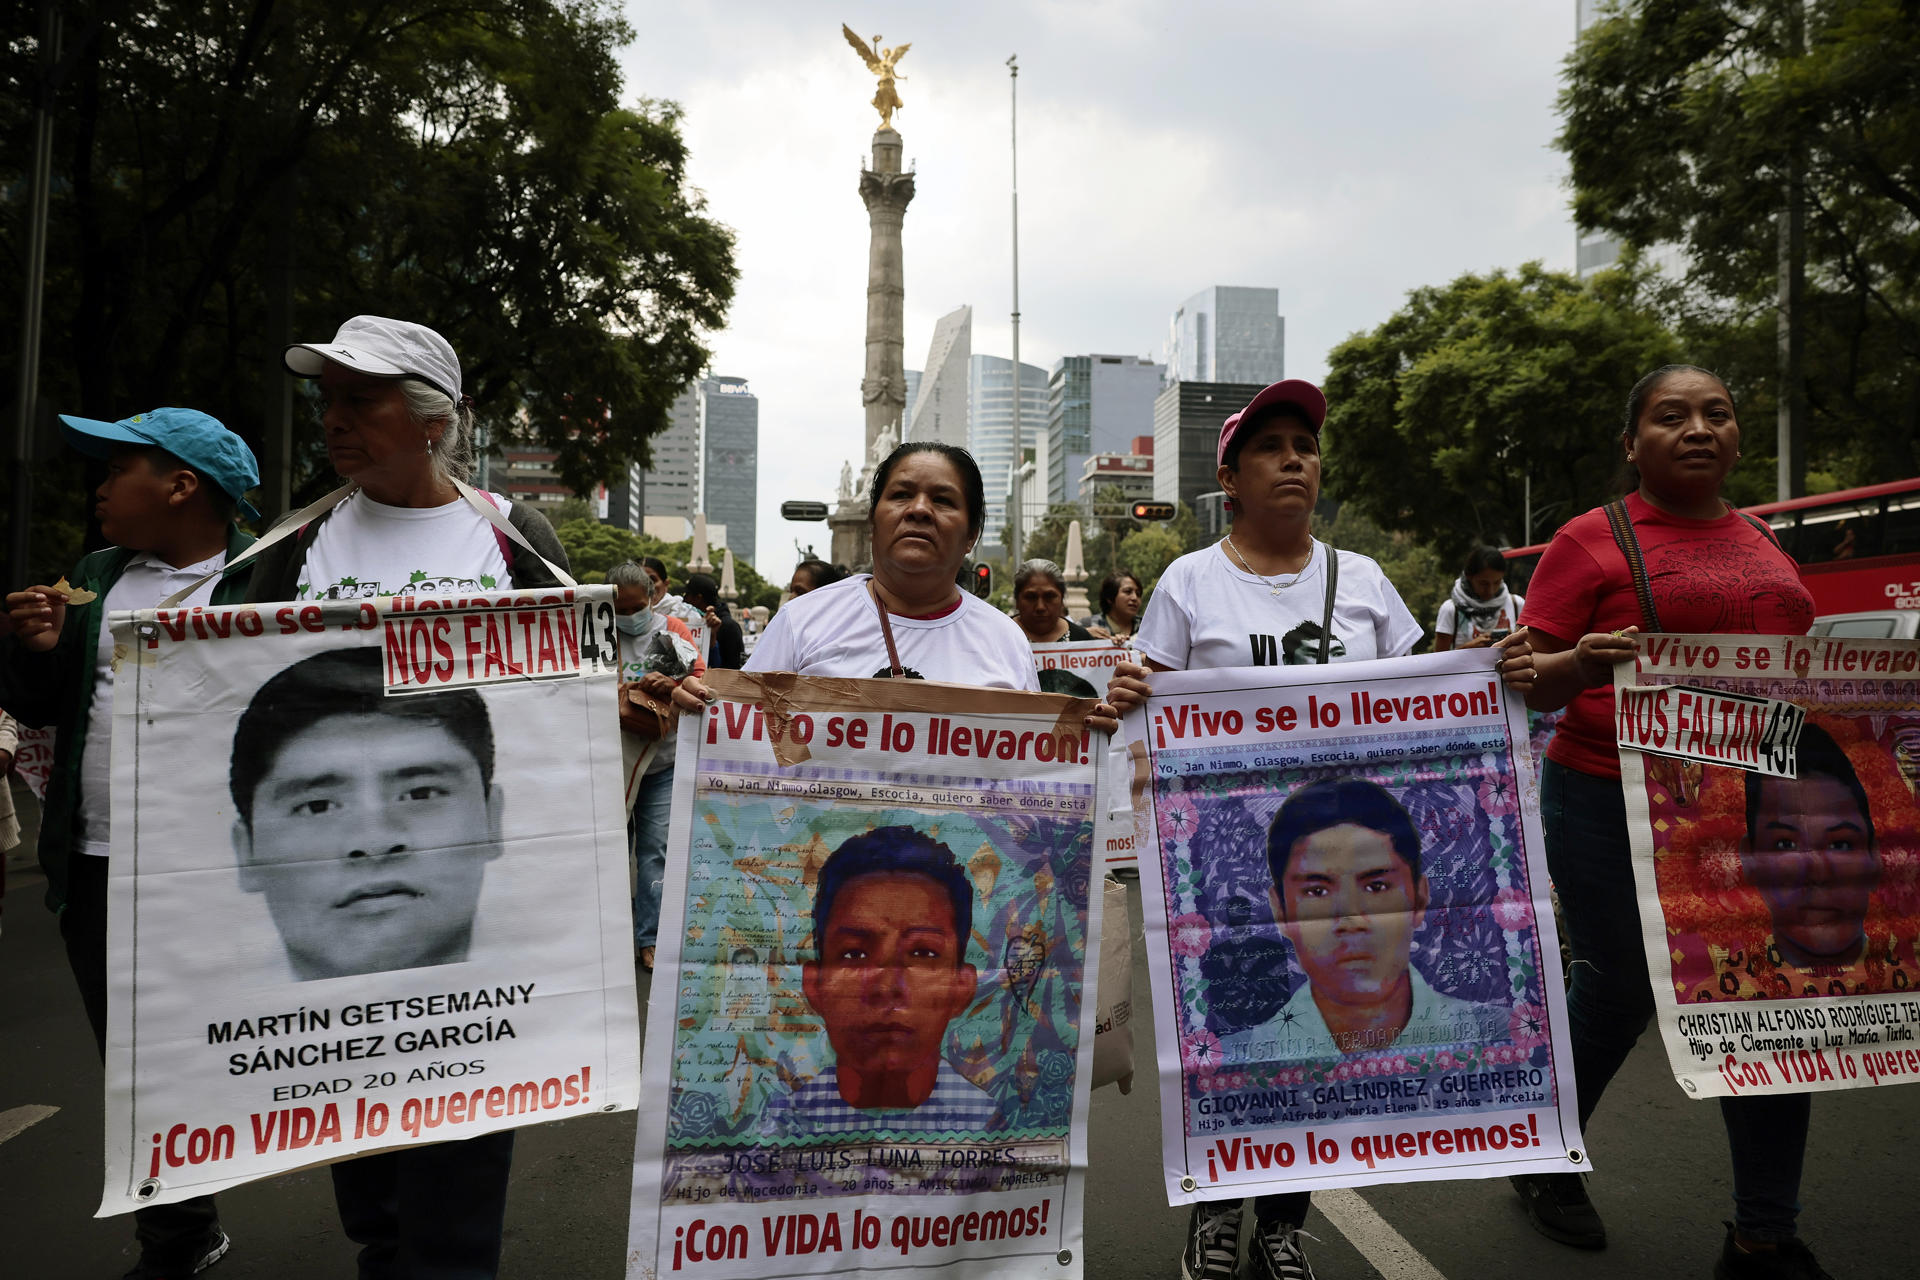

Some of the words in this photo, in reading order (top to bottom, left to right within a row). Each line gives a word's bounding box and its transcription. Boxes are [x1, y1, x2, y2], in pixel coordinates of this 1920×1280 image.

[720, 383, 750, 395] BBVA
[277, 607, 327, 634] se
[342, 602, 378, 631] o
[384, 617, 455, 685] NOS
[467, 604, 580, 679] FALTAN
[582, 601, 617, 672] 43
[1042, 655, 1056, 671] lo
[1735, 646, 1771, 671] se
[1784, 641, 1812, 671] lo
[1823, 642, 1920, 674] llevaro
[706, 703, 815, 745] ¡Vivo
[827, 716, 869, 749] se
[881, 714, 915, 753] lo
[927, 717, 1091, 765] llevaron!
[1155, 704, 1244, 748] ¡Vivo
[1255, 704, 1298, 733] se
[1309, 695, 1341, 729] lo
[1352, 682, 1500, 726] llevaron!
[1619, 688, 1670, 746] NOS
[1676, 693, 1767, 764] FALTAN
[1760, 701, 1806, 776] 43!
[1159, 764, 1178, 775] Yo,
[1186, 762, 1205, 772] Jan
[1210, 760, 1248, 770] Nimmo,
[1254, 756, 1305, 768] Glasgow,
[1311, 750, 1360, 763] Escocia,
[1367, 748, 1405, 760] quiero
[1410, 744, 1441, 755] saber
[1446, 740, 1476, 752] dónde
[1482, 738, 1506, 749] está
[709, 777, 729, 790] Yo,
[739, 779, 760, 790] Jan
[871, 788, 924, 803] Escocia,
[932, 791, 973, 807] quiero
[980, 794, 1013, 806] saber
[1020, 796, 1053, 808] dónde
[1060, 798, 1086, 809] está
[1106, 835, 1134, 851] mos!
[208, 1005, 331, 1044] MARTÍN
[340, 983, 536, 1027] GETSEMANY
[1678, 1011, 1752, 1037] CHRISTIAN
[1758, 1008, 1826, 1032] ALFONSO
[1828, 1000, 1901, 1028] RODRÍGUEZ
[229, 1036, 386, 1076] SÁNCHEZ
[395, 1018, 516, 1054] GARCÍA
[1689, 1037, 1713, 1061] Hijo
[1719, 1038, 1736, 1054] de
[1741, 1033, 1805, 1053] Clemente
[1811, 1037, 1819, 1053] y
[1825, 1030, 1844, 1048] Luz
[273, 1077, 352, 1102] EDAD
[364, 1072, 397, 1089] 20
[407, 1059, 485, 1083] AÑOS
[1718, 1054, 1773, 1095] ¡Con
[1772, 1048, 1834, 1084] VIDA
[1836, 1047, 1858, 1080] lo
[1198, 1089, 1301, 1115] GIOVANNI
[1312, 1078, 1428, 1104] GALINDREZ
[1440, 1069, 1543, 1094] GUERRERO
[1198, 1119, 1225, 1131] Hijo
[1230, 1116, 1245, 1126] de
[1282, 1110, 1327, 1122] Alfredo
[1332, 1110, 1340, 1120] y
[1384, 1103, 1417, 1114] Elena
[1436, 1100, 1449, 1109] 19
[1455, 1097, 1481, 1107] años
[1499, 1091, 1545, 1104] Arcelia
[149, 1124, 234, 1178] ¡Con
[251, 1105, 341, 1155] VIDA
[354, 1097, 389, 1140] lo
[401, 1066, 591, 1138] queremos!
[723, 1150, 781, 1174] JOSÉ
[868, 1148, 922, 1168] LUNA
[938, 1147, 1017, 1169] TORRES
[1207, 1137, 1296, 1183] ¡Vivo
[1308, 1131, 1339, 1165] lo
[1351, 1113, 1541, 1169] queremos!
[676, 1187, 711, 1201] Hijo
[720, 1185, 737, 1197] de
[744, 1182, 818, 1198] Macedonia
[841, 1179, 857, 1191] 20
[863, 1177, 894, 1189] años
[1000, 1172, 1050, 1187] MORELOS
[672, 1219, 749, 1271] ¡Con
[763, 1212, 843, 1258] VIDA
[852, 1209, 881, 1252] lo
[891, 1199, 1051, 1257] queremos!
